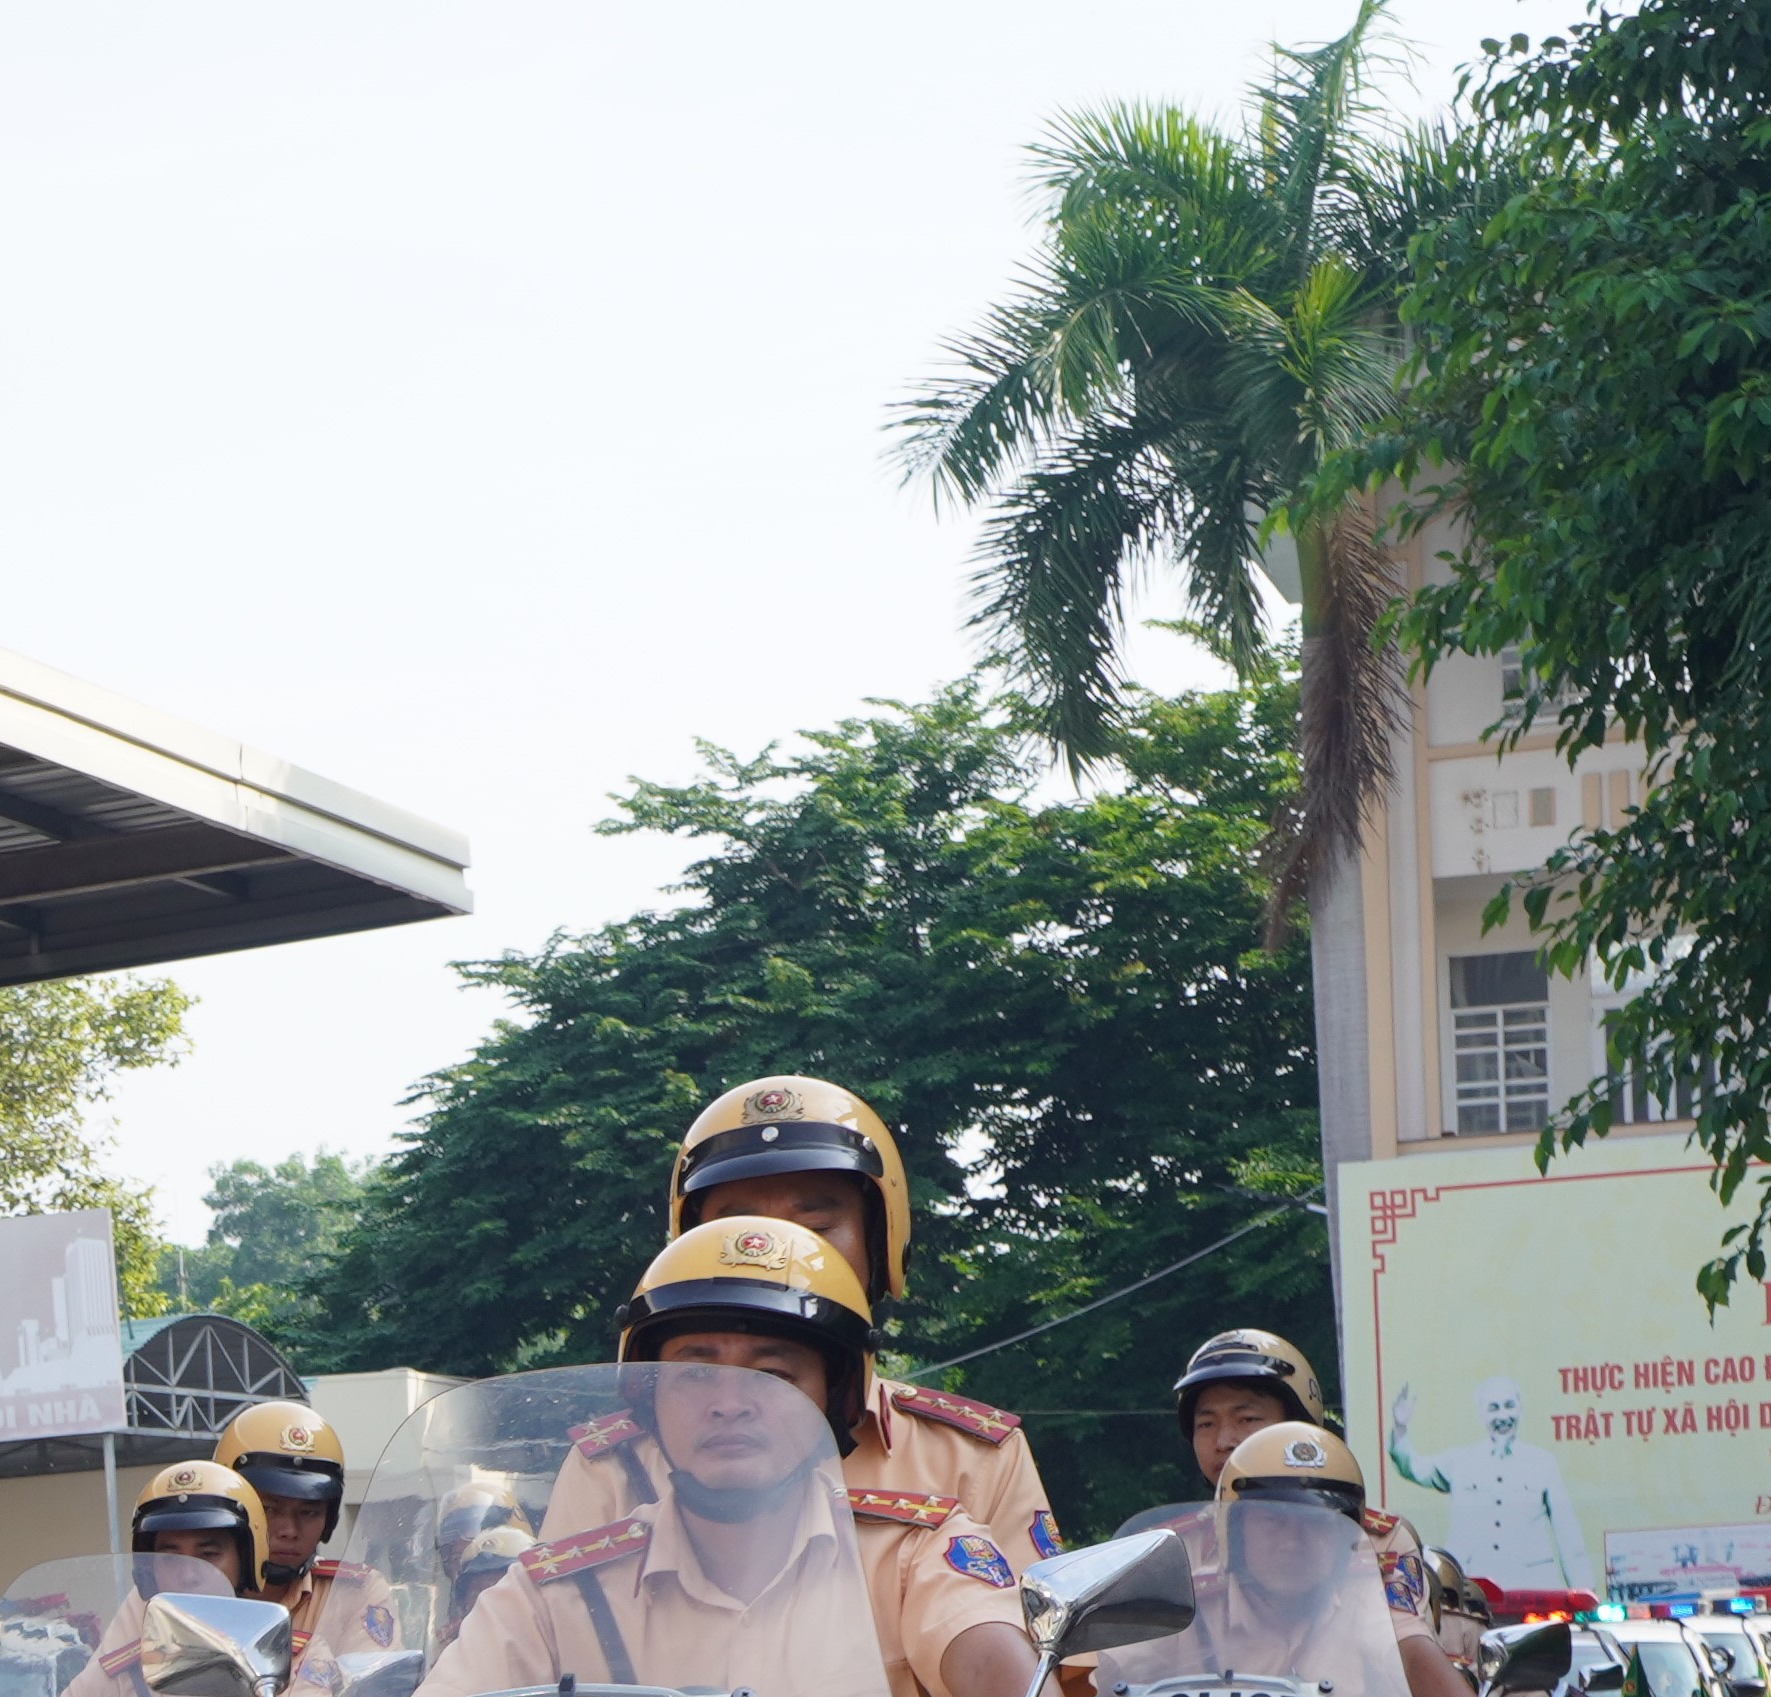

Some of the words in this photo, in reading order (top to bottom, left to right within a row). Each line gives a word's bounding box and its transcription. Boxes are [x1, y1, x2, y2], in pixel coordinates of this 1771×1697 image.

[1558, 1362, 1625, 1398] THỰC
[1634, 1355, 1696, 1394] HIỆN
[1704, 1355, 1756, 1386] CAO
[28, 1396, 103, 1425] NHÀ
[1551, 1407, 1614, 1446] TRẬT
[1622, 1406, 1656, 1443] TỰ
[1663, 1401, 1699, 1436] XÃ
[1706, 1398, 1750, 1437] HỘI
